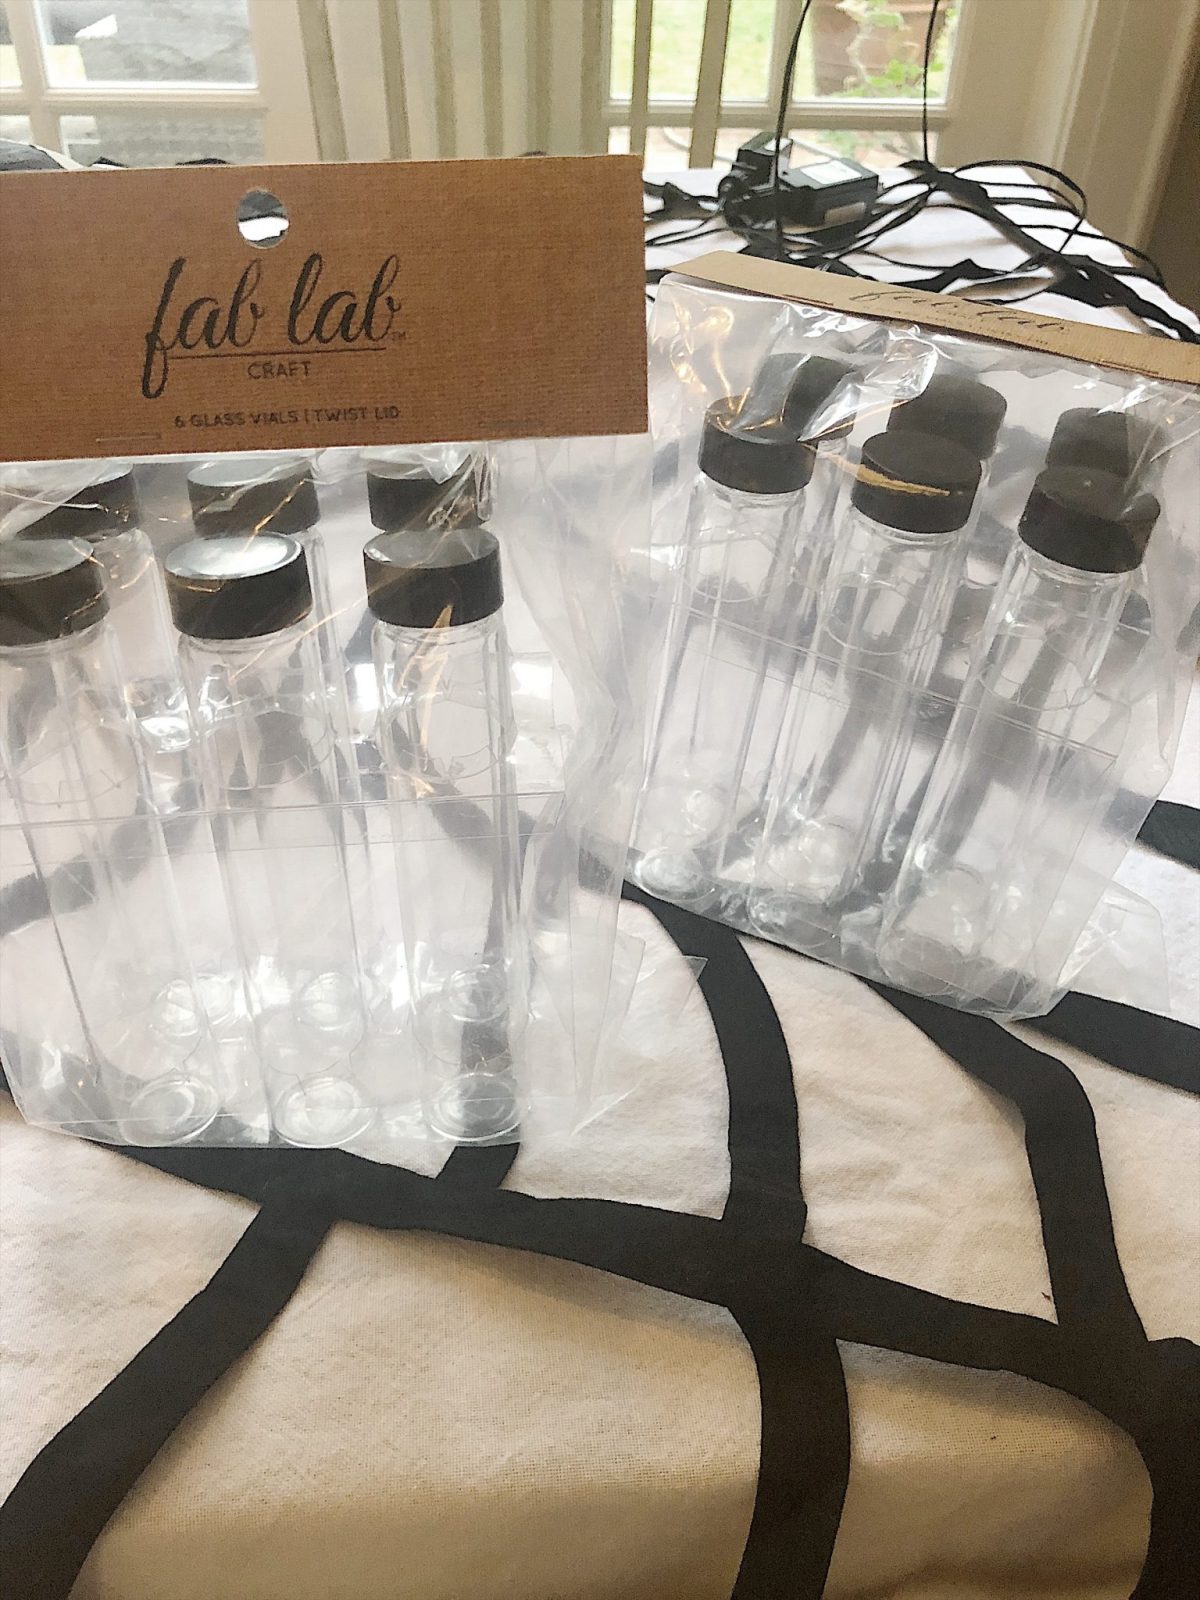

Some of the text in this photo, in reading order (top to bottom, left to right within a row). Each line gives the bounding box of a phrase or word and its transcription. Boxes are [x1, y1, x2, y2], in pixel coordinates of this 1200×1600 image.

[142, 256, 264, 398] fab
[287, 253, 402, 345] lab
[247, 361, 311, 379] CRAFT
[174, 415, 186, 428] 6
[190, 412, 246, 427] GLASS
[250, 409, 299, 424] VIALS
[313, 406, 368, 422] TWIST
[375, 405, 400, 420] LID
